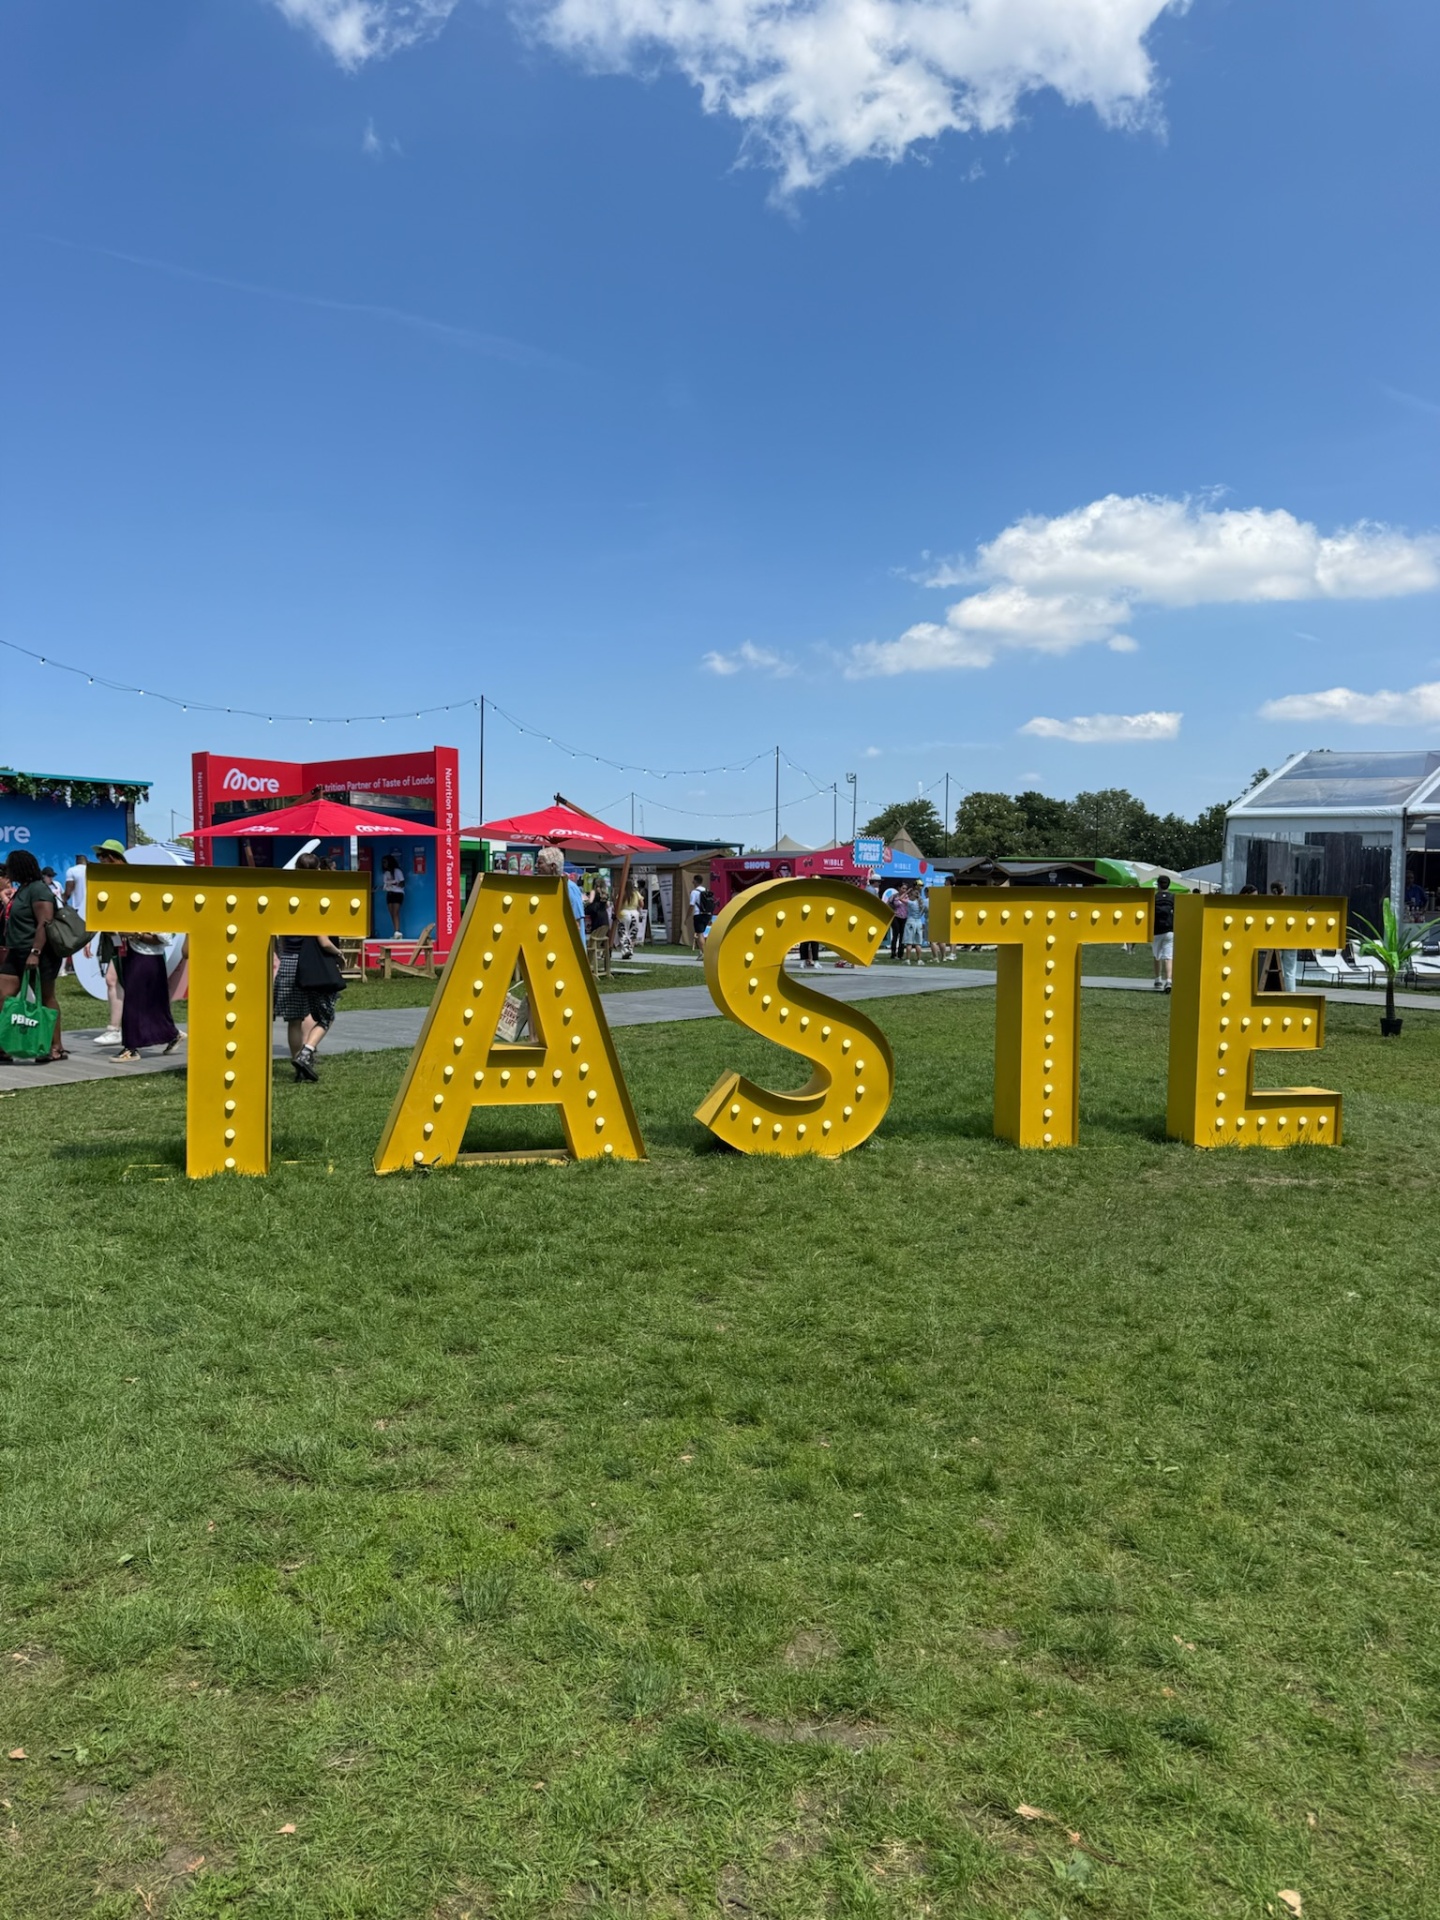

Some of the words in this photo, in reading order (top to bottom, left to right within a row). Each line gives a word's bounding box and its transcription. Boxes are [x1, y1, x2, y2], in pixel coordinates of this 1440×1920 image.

[223, 767, 280, 793] More
[316, 783, 346, 792] trition
[373, 779, 382, 788] of
[383, 777, 401, 787] Taste
[402, 776, 411, 785] of
[445, 767, 453, 810] Nutrition
[446, 849, 455, 860] of
[823, 858, 844, 867] WIBBLE
[446, 862, 454, 887] Taste
[744, 861, 771, 870] SHOTS
[446, 888, 455, 899] of
[446, 901, 455, 935] London
[85, 864, 1348, 1179] TASTE
